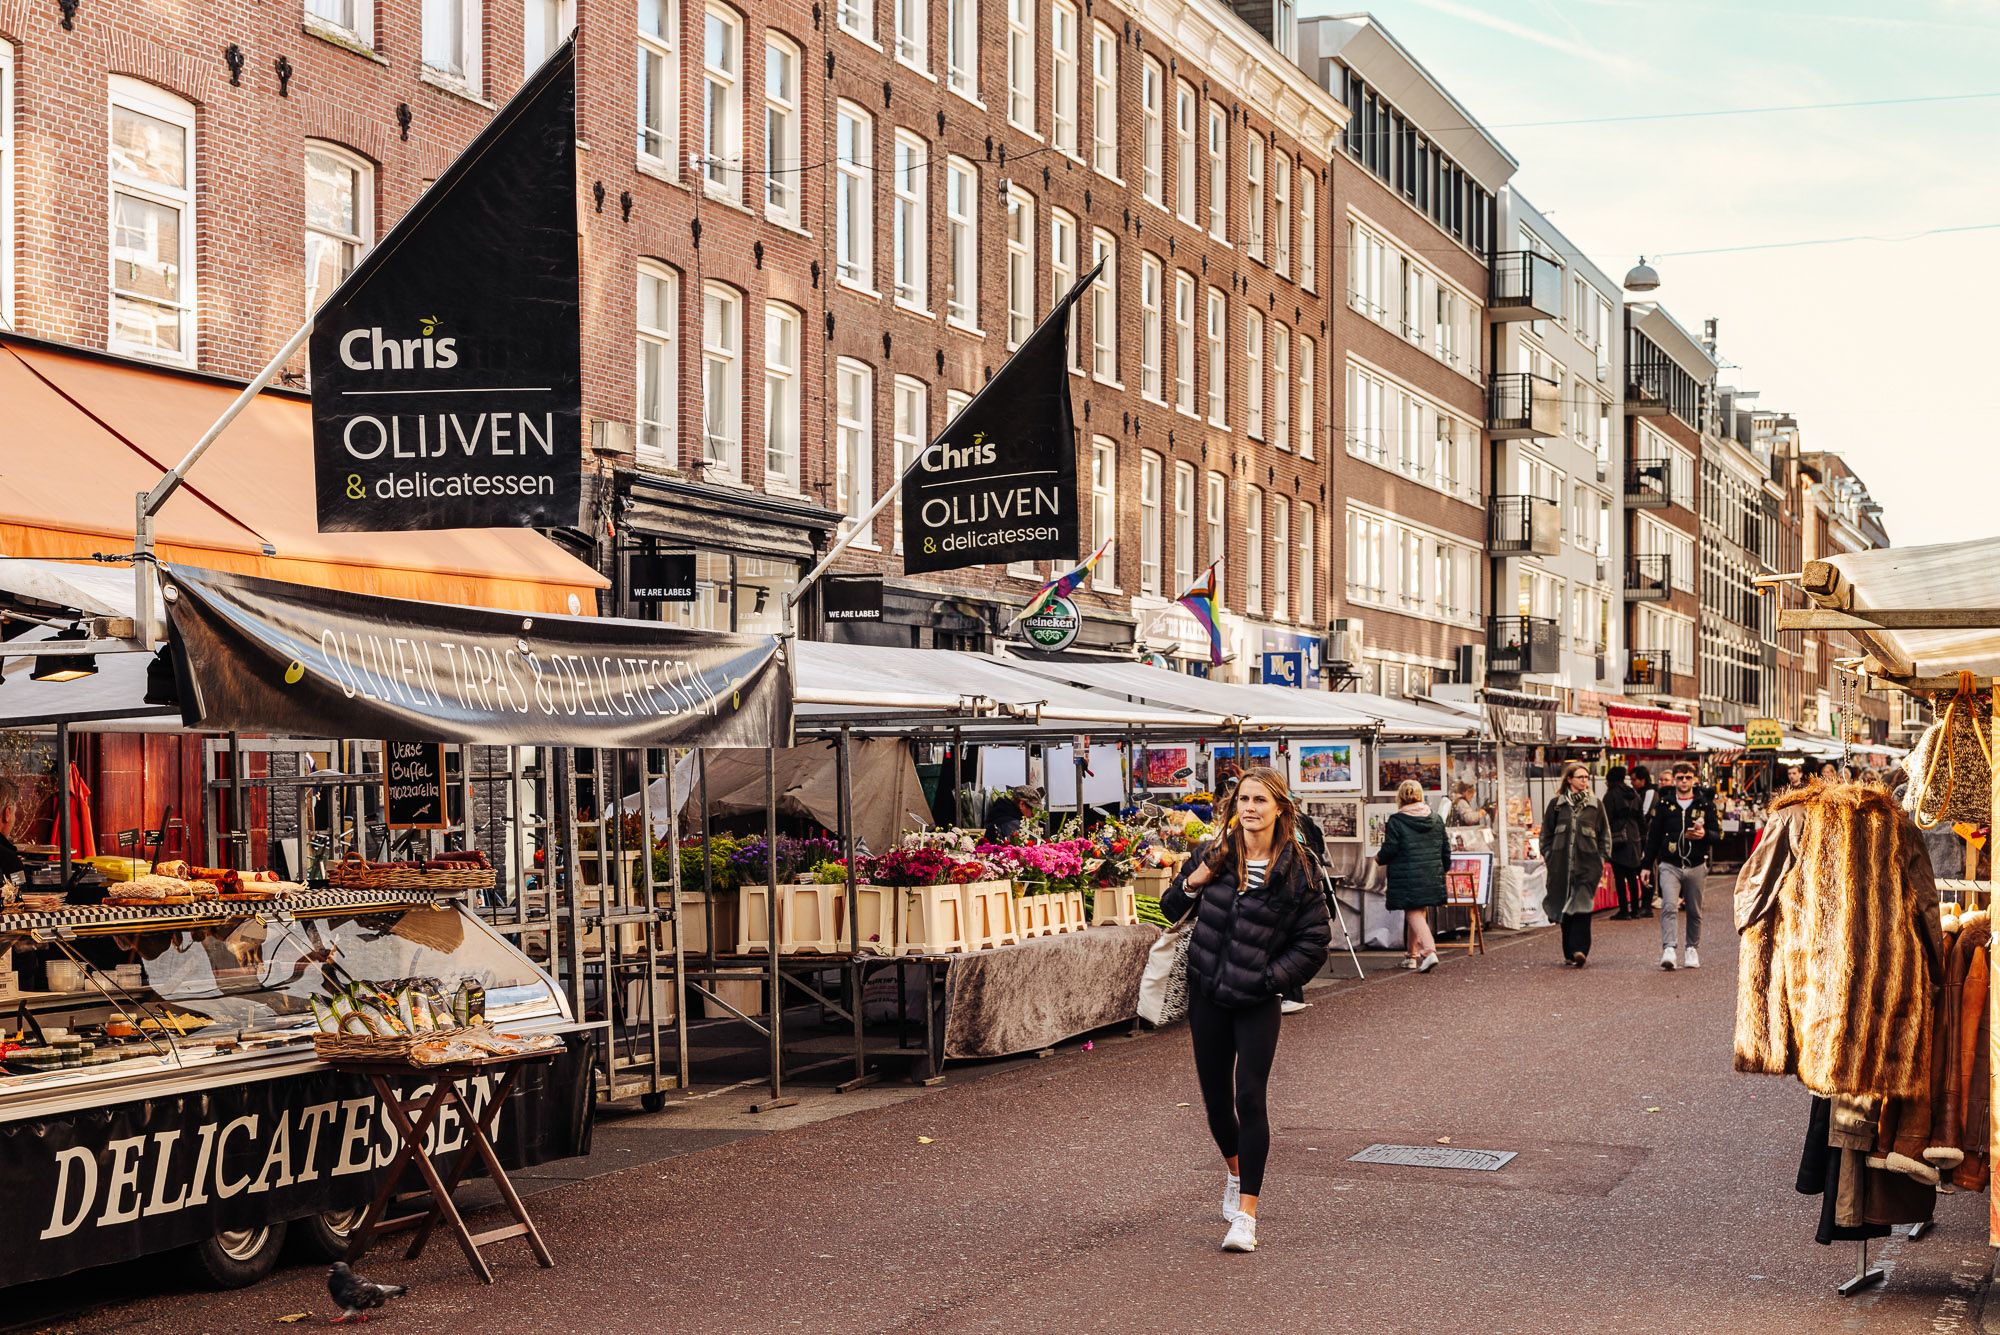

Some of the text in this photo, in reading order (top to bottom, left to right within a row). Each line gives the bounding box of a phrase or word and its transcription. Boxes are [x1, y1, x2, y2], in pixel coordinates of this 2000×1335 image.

[339, 327, 458, 371] Chris
[343, 412, 553, 460] OLIJVEN
[920, 441, 997, 472] Chris
[346, 472, 554, 500] & delicatessen
[921, 486, 1059, 528] OLIJVEN
[923, 527, 1059, 554] & delicatessen
[634, 588, 692, 597] WE ARE LABELS
[829, 609, 880, 618] WE ARE LABELS
[321, 629, 719, 716] OLIJVEN TAPAS & DELICATESSEN
[40, 1072, 505, 1240] DELICATESSEN
